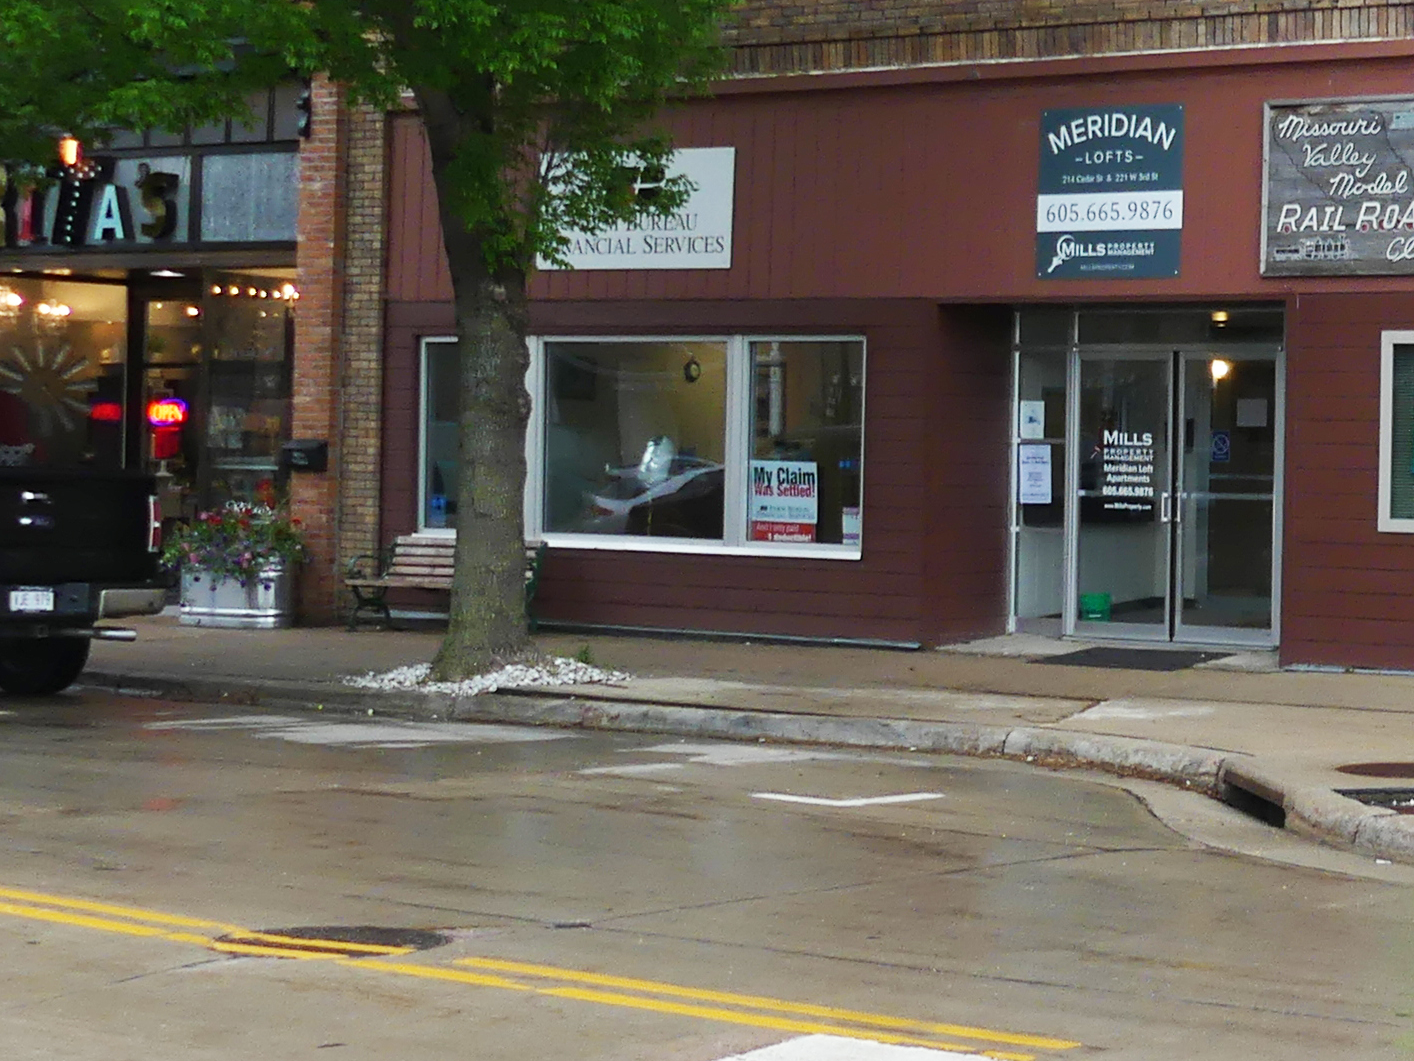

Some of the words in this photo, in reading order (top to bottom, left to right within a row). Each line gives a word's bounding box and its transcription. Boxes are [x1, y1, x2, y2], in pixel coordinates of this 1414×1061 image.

[1048, 113, 1176, 155] MERIDIAN
[1278, 115, 1381, 141] Missouri
[1303, 143, 1376, 178] Valley
[1329, 171, 1408, 198] Model
[1046, 200, 1173, 223] 605.665.9876
[1277, 203, 1346, 232] RAIL
[562, 236, 636, 255] NANCIAL
[643, 235, 725, 254] SERVICES
[1062, 242, 1106, 257] MILLS
[153, 404, 184, 422] OPEN
[1104, 430, 1153, 446] MILLS
[754, 467, 773, 486] My
[777, 467, 815, 485] Claim
[1104, 463, 1137, 473] Meridian
[1139, 464, 1153, 473] Loft
[1107, 473, 1150, 483] Apartments
[755, 483, 773, 496] Was
